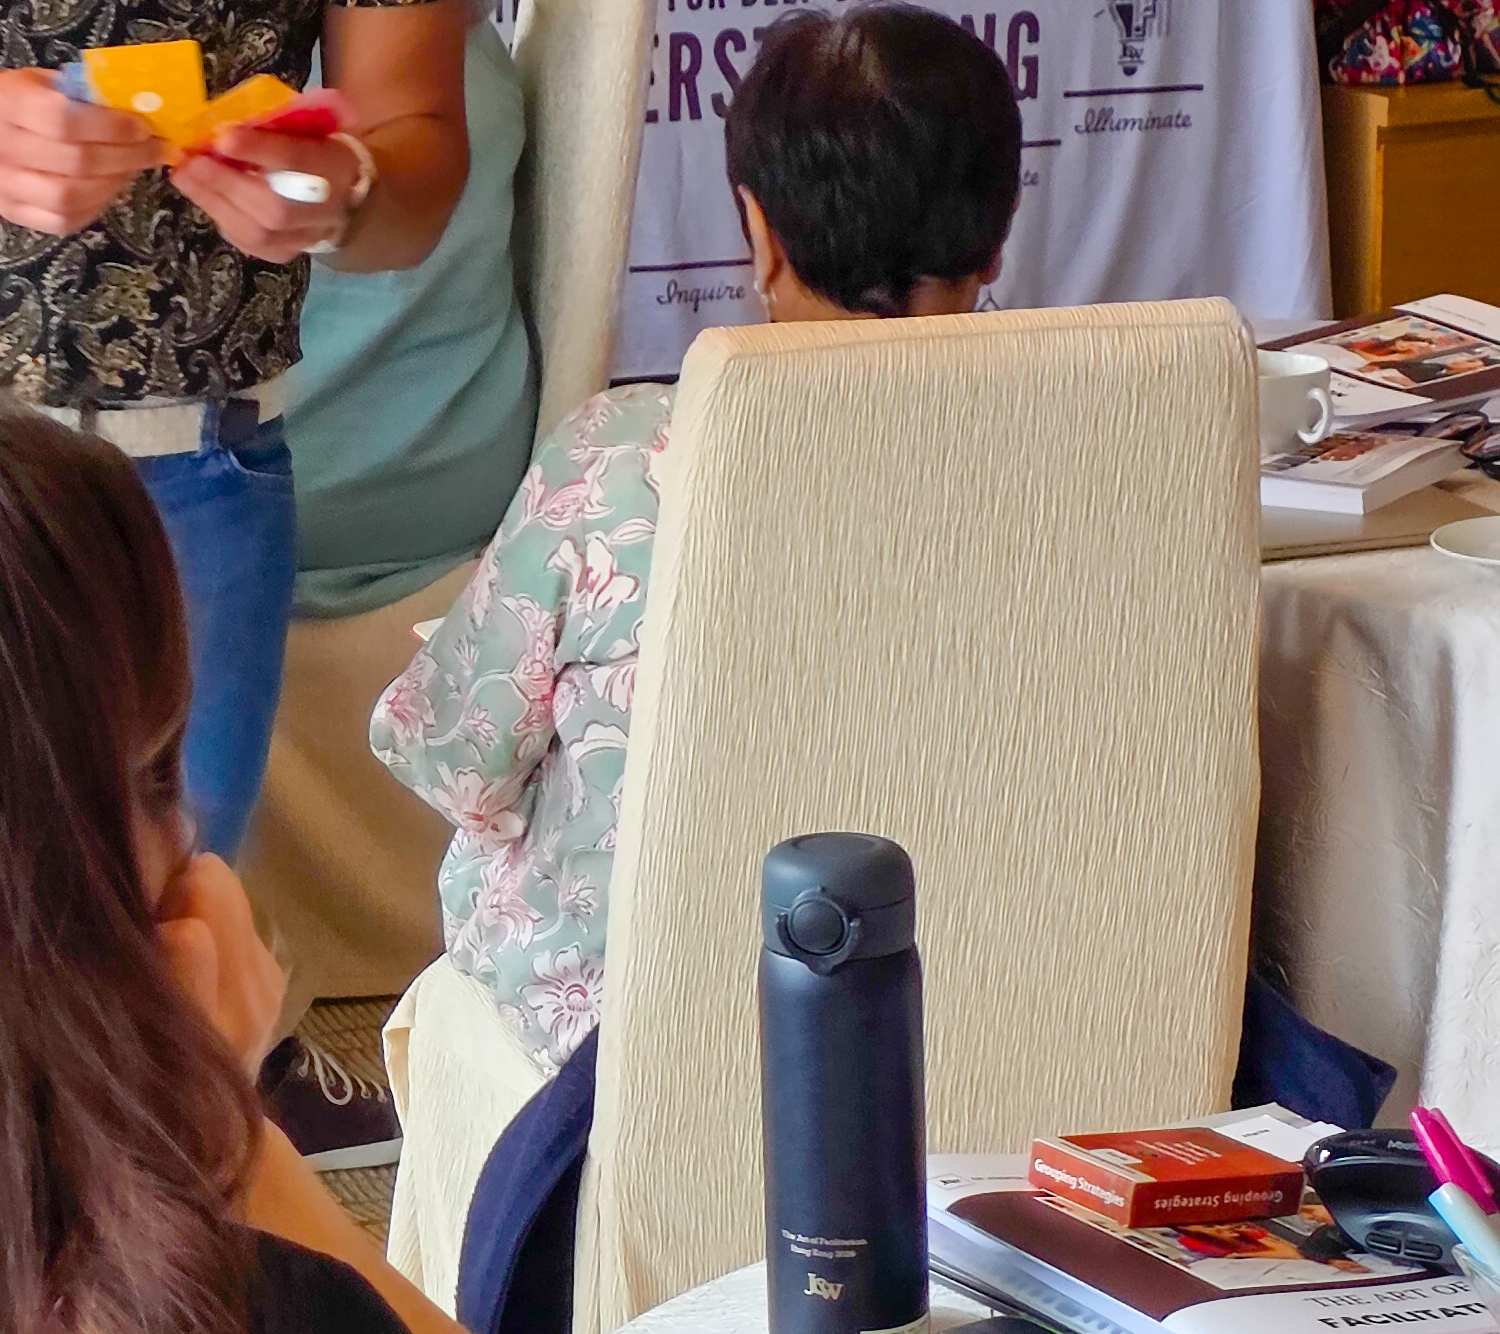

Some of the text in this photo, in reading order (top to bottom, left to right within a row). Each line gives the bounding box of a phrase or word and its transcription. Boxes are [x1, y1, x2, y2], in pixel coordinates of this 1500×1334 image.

[1074, 106, 1193, 135] Illuminate
[655, 278, 747, 314] Inquire
[1034, 1158, 1125, 1208] Grouping Strategies
[1154, 1190, 1284, 1212] Grouping Strategies
[1303, 1280, 1472, 1308] THE ART OF
